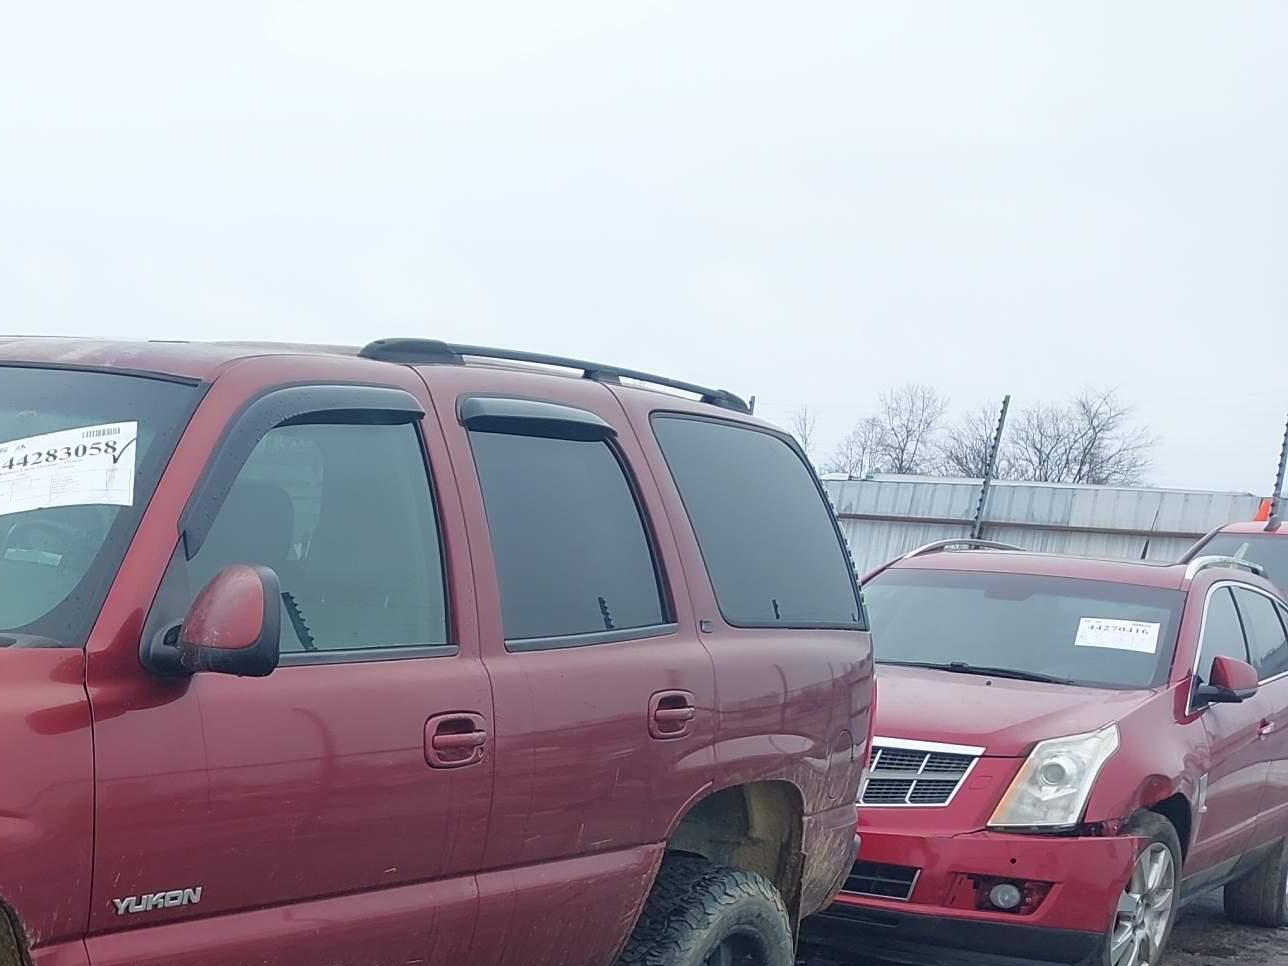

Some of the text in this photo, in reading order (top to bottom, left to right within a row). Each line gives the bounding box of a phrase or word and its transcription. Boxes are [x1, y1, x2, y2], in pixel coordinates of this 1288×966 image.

[1, 439, 117, 470] 44283058
[1088, 625, 1149, 635] 44270416
[113, 886, 202, 915] YUKON
